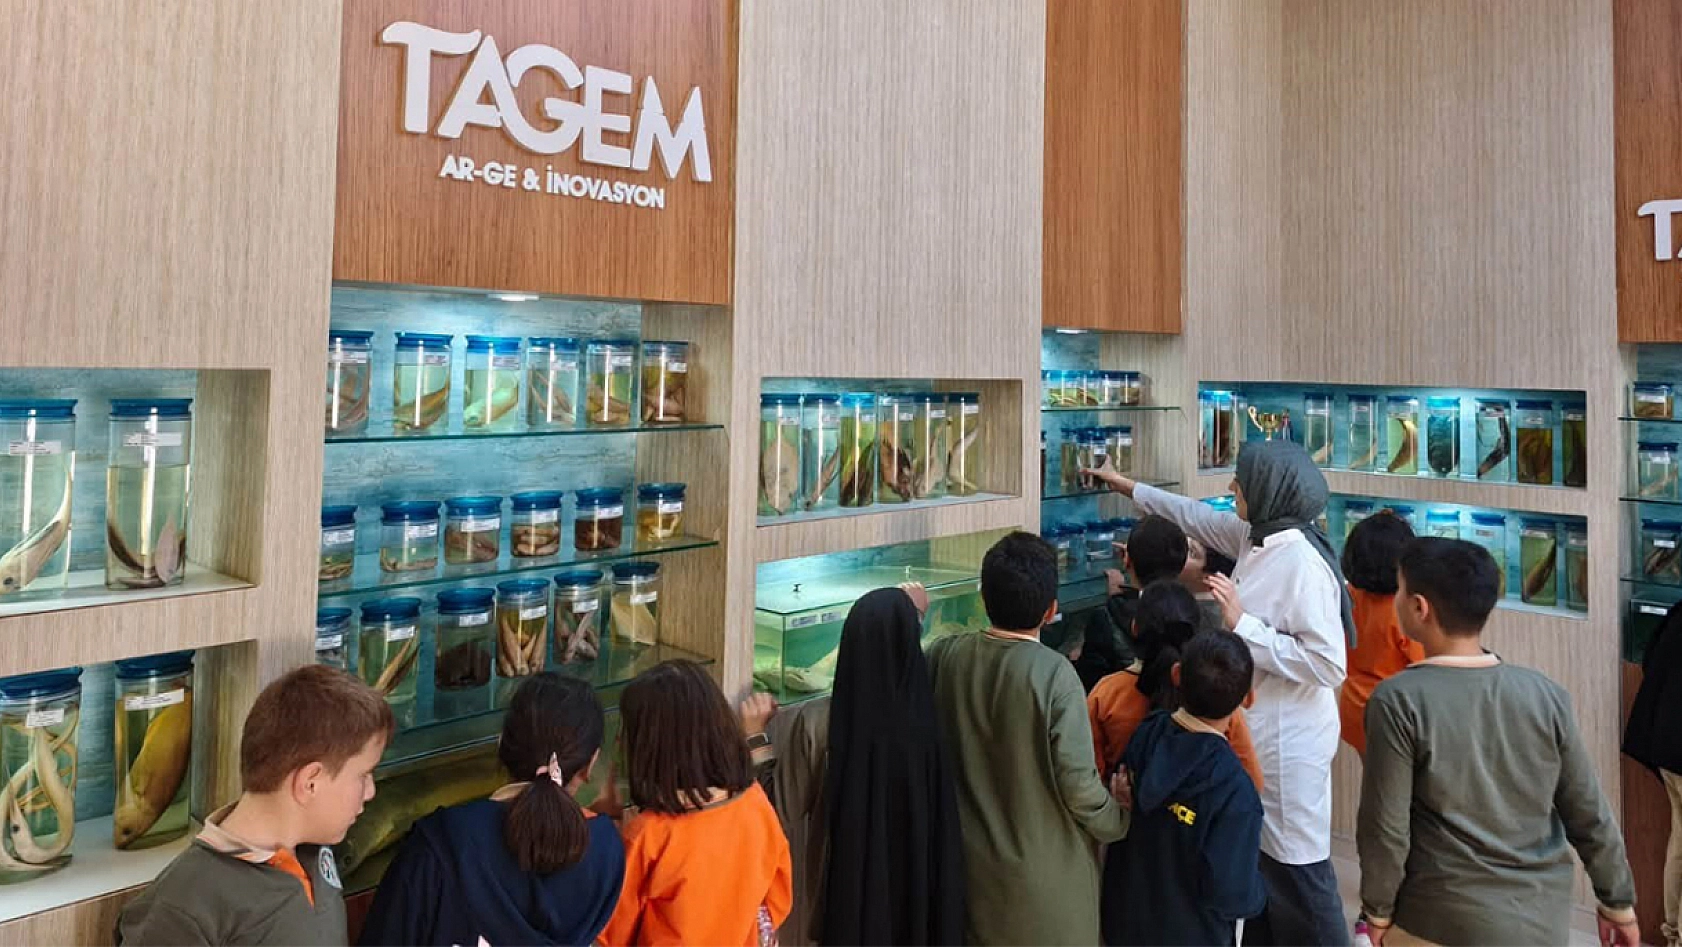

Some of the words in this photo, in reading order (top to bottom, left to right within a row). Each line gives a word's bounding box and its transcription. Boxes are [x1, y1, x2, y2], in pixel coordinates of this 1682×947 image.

[382, 21, 712, 182] TAGEM
[440, 155, 516, 188] AR-GE
[523, 168, 540, 191] &
[546, 166, 665, 208] İNOVASYON
[1638, 199, 1682, 261] T
